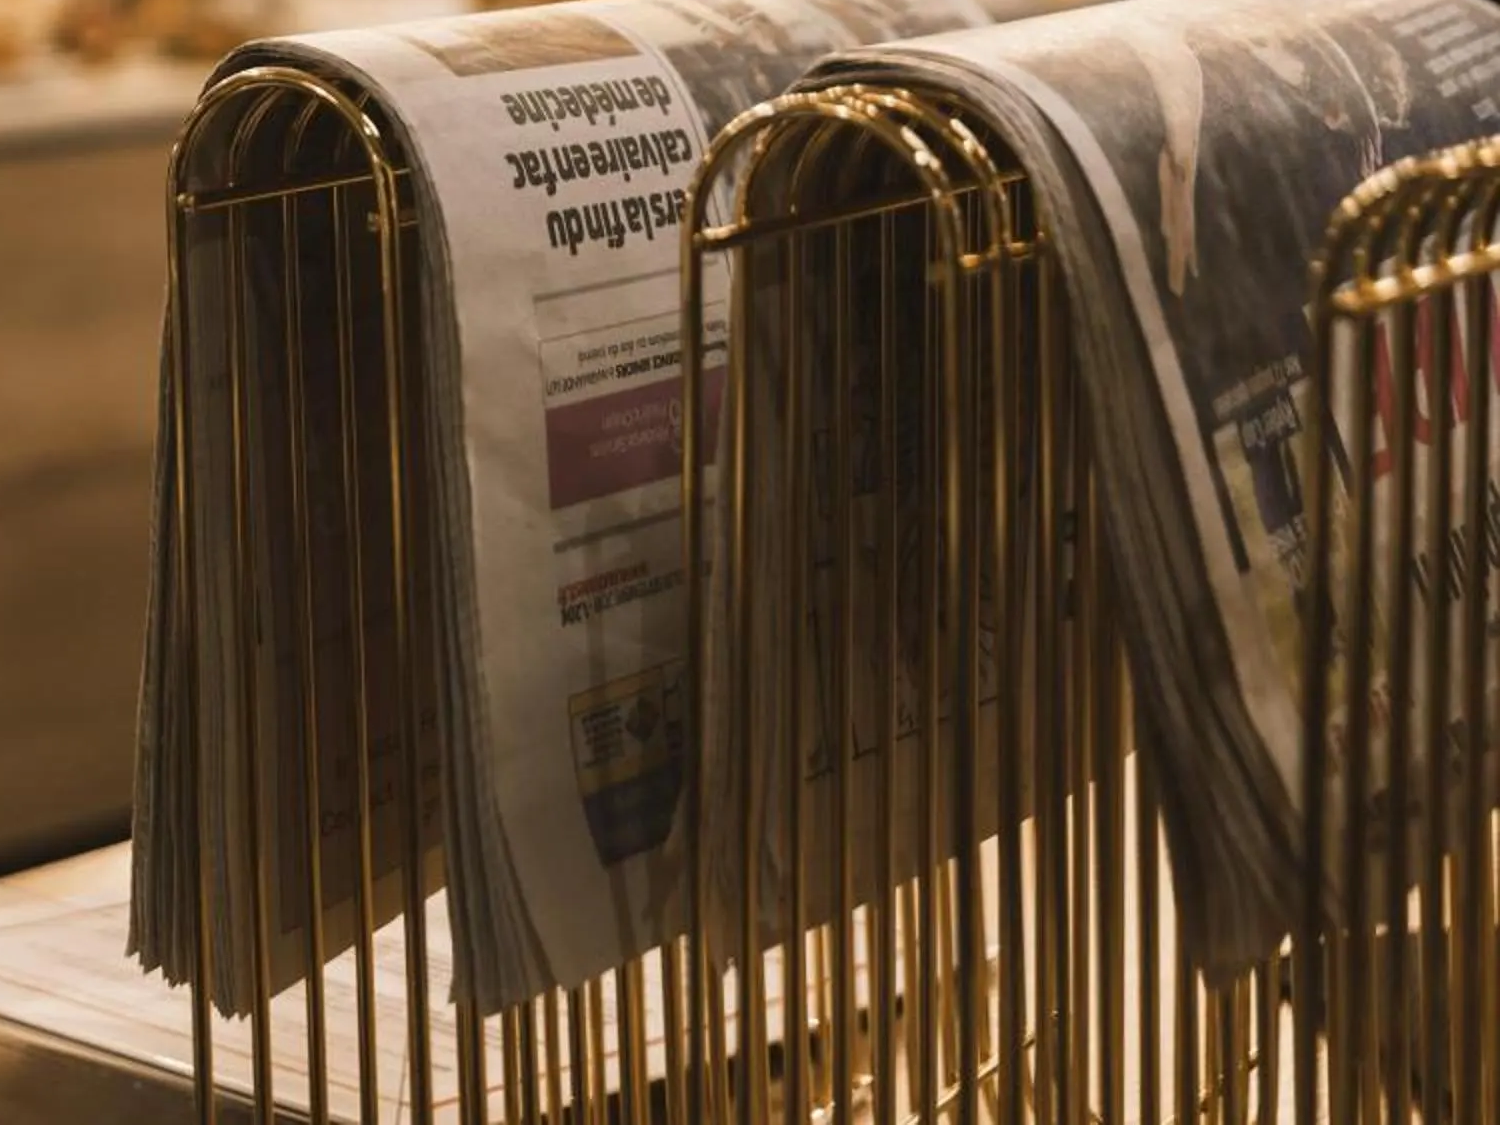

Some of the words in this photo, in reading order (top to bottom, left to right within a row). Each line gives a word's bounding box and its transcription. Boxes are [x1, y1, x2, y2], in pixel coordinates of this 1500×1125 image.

[499, 80, 641, 132] médecine
[636, 75, 672, 116] de
[504, 148, 557, 197] fac
[555, 144, 589, 175] en
[588, 128, 694, 182] calvaire
[545, 208, 585, 256] du
[584, 201, 626, 250] fin
[621, 195, 653, 242] la
[650, 189, 688, 231] ers
